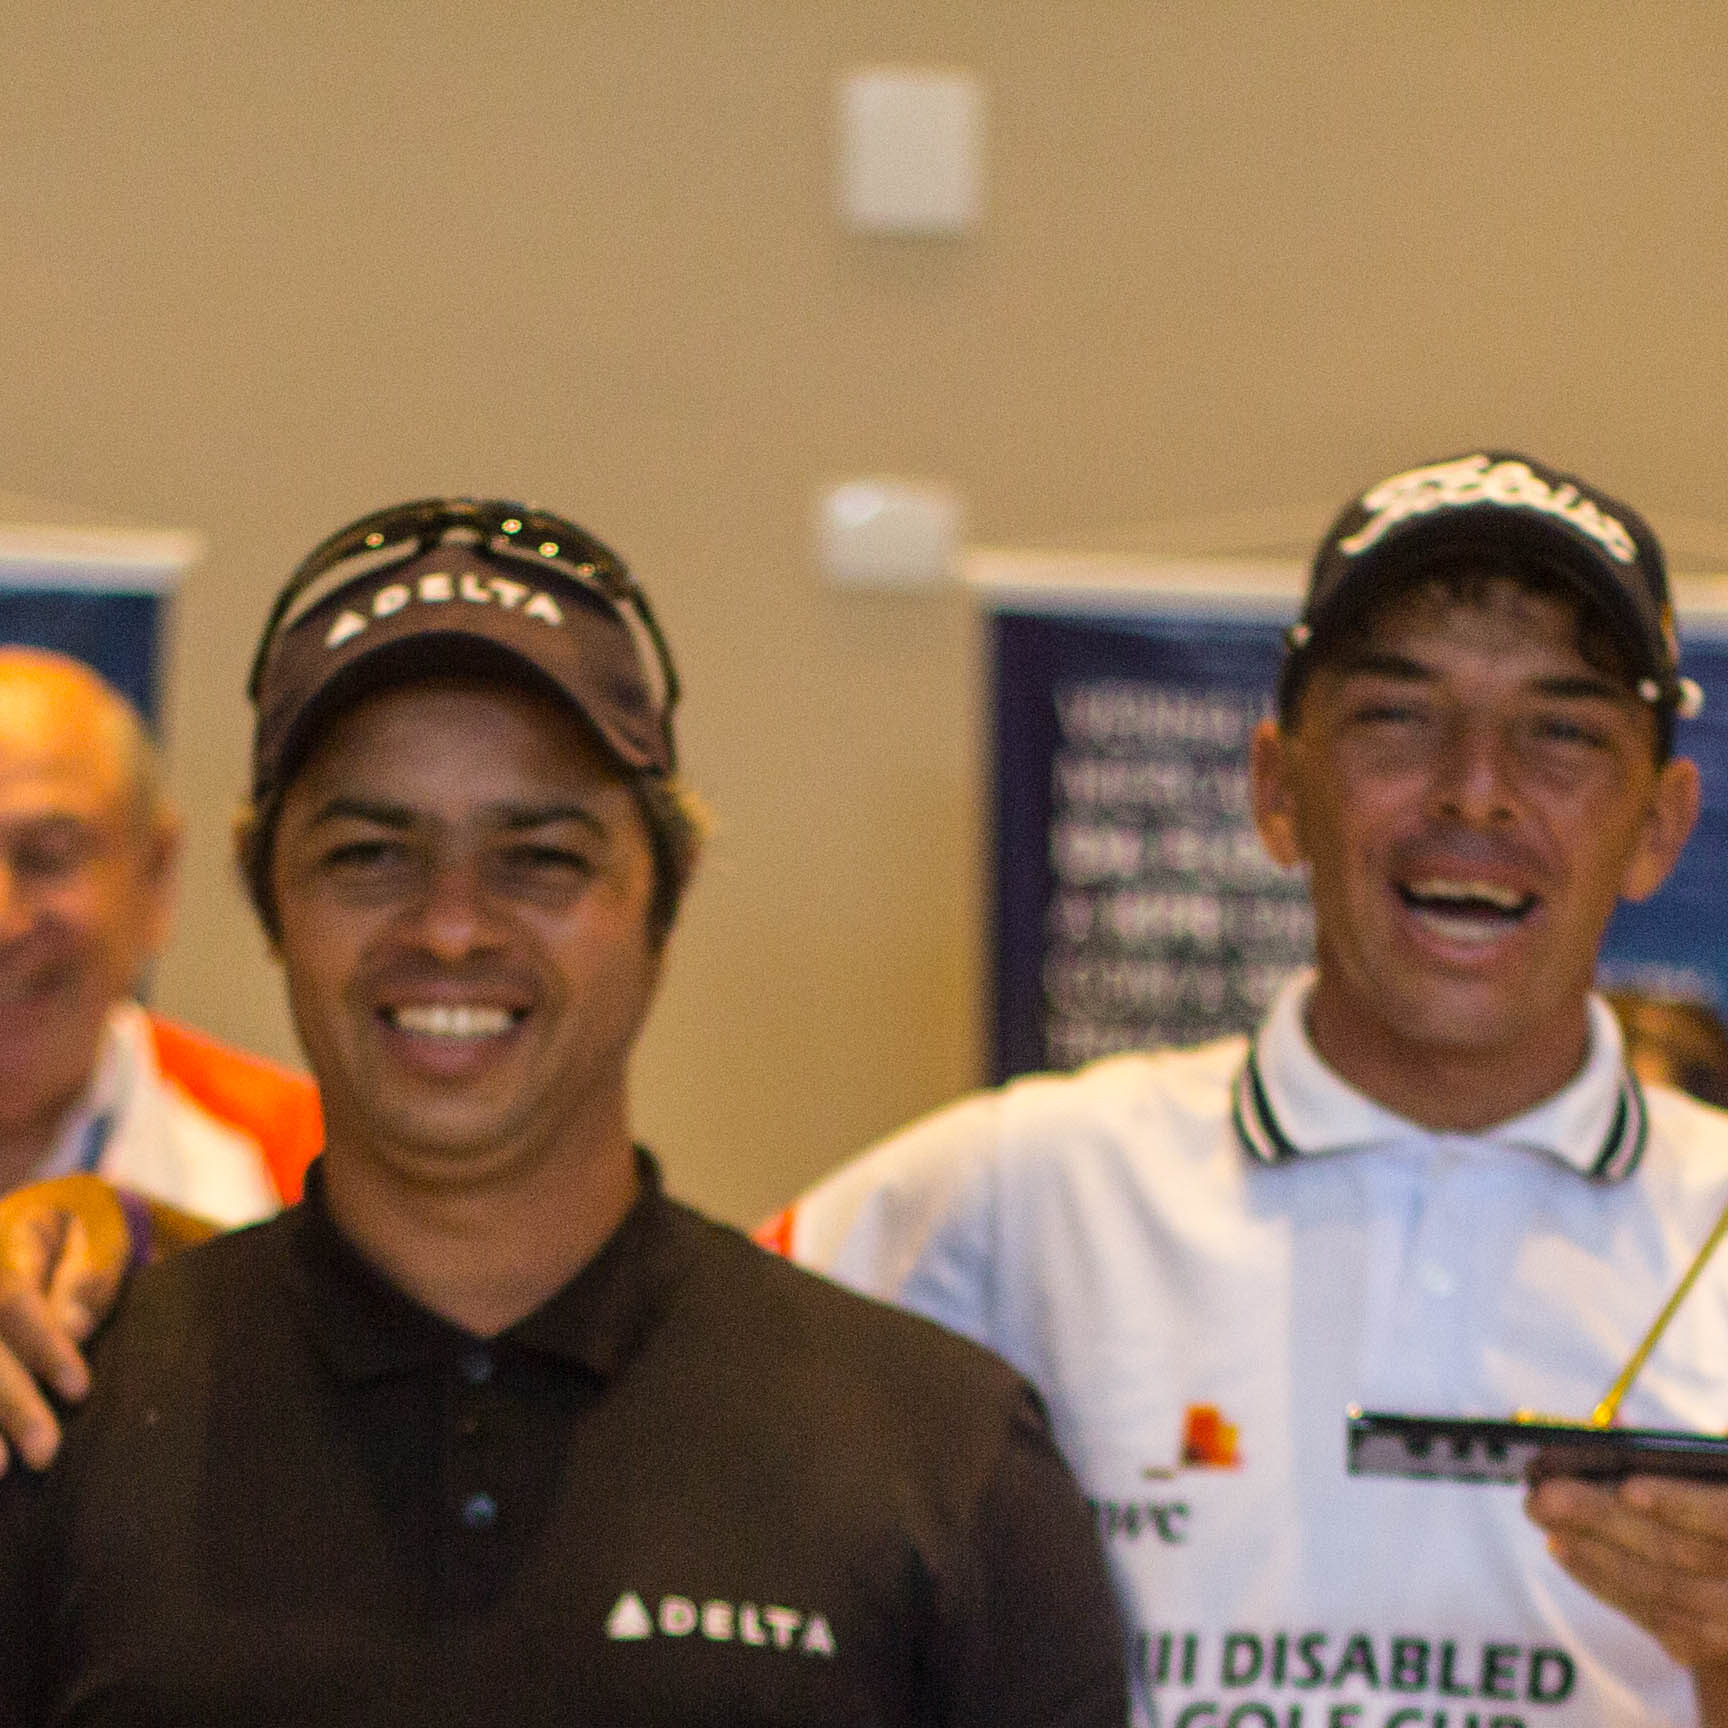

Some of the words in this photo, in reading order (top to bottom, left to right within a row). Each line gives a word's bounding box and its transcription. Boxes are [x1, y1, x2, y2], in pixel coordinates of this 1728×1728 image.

[372, 571, 565, 629] DELTA
[1089, 1497, 1193, 1546] wc
[658, 1594, 837, 1658] DELTA
[1220, 1629, 1579, 1707] DISABLED
